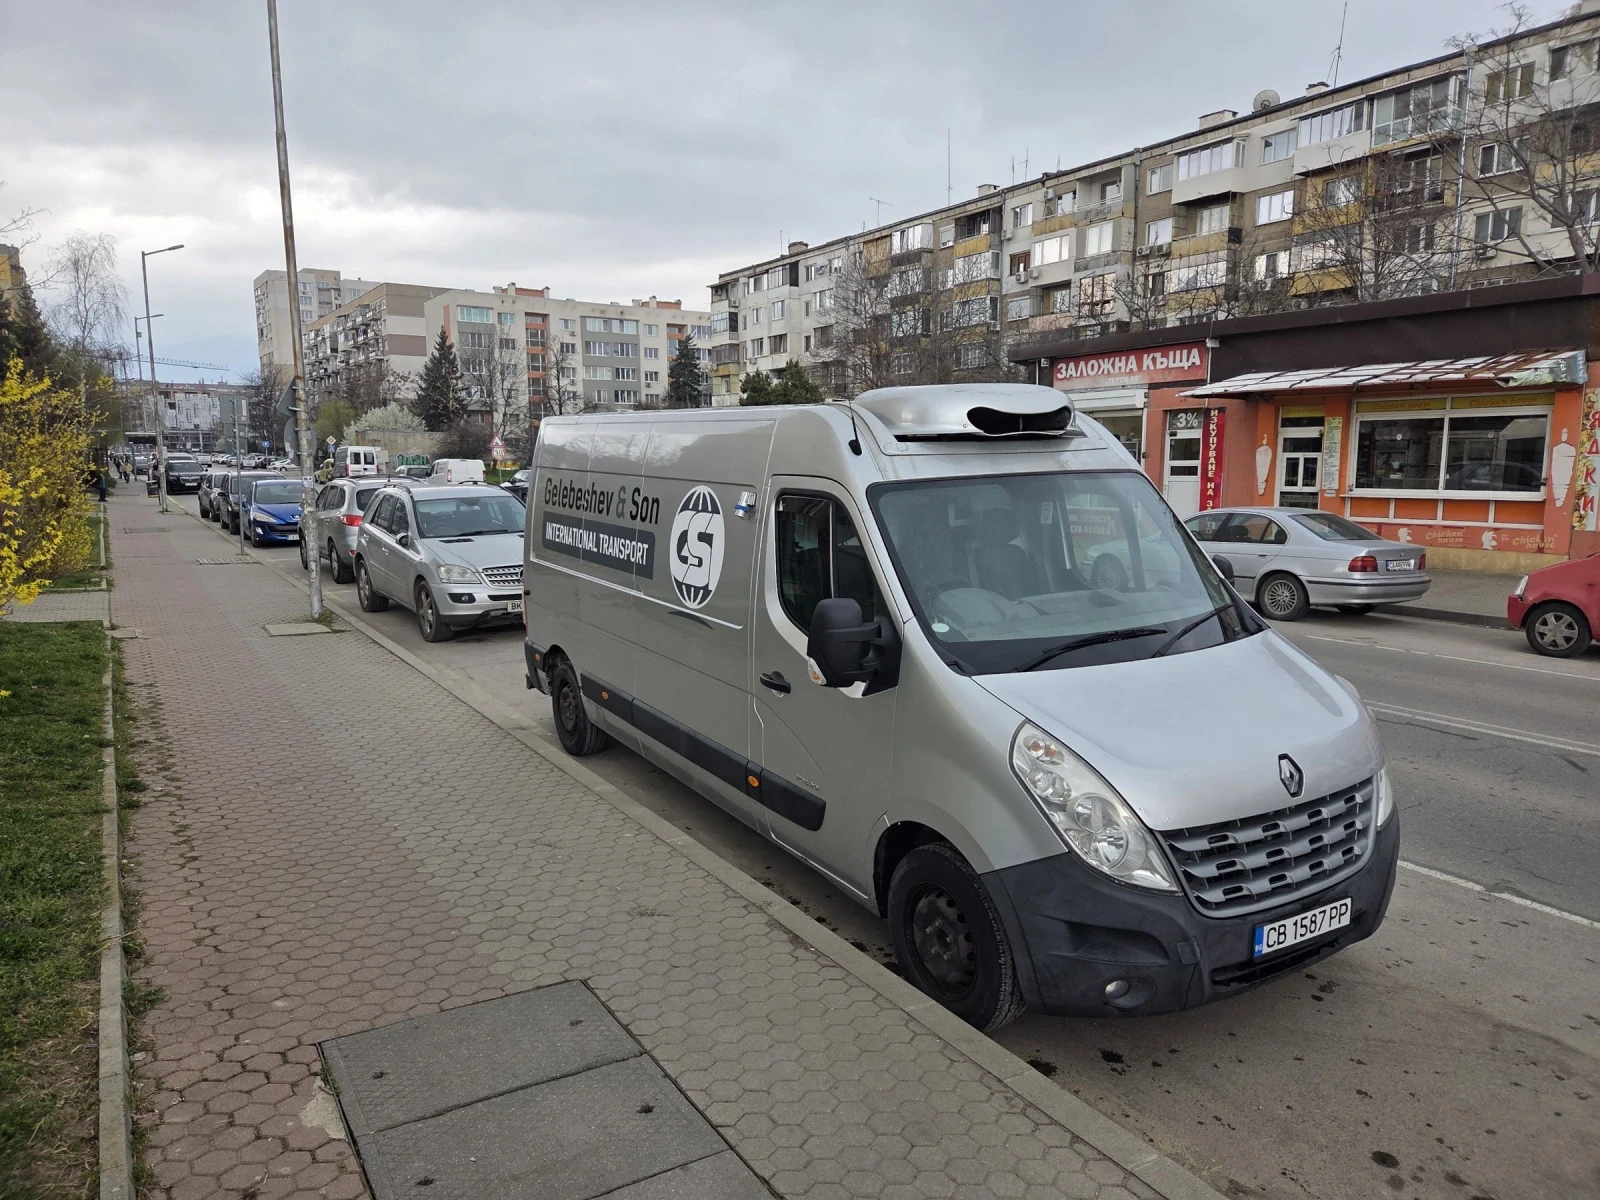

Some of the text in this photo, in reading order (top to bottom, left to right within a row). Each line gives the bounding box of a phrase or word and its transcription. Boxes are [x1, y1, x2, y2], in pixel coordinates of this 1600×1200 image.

[1056, 348, 1201, 379] ЗАЛОЖНА КЪЩА
[1176, 412, 1198, 428] 3%
[1208, 409, 1219, 478] ИЗКУПУВАНЕ
[544, 477, 660, 525] Gelebeshev & Son
[1206, 482, 1215, 496] НА
[545, 521, 649, 566] INTERNATIONAL TRANSPORT
[1426, 530, 1464, 540] Chicken
[1266, 924, 1287, 948] CB
[1293, 909, 1327, 940] 1587
[1329, 902, 1349, 928] PP
